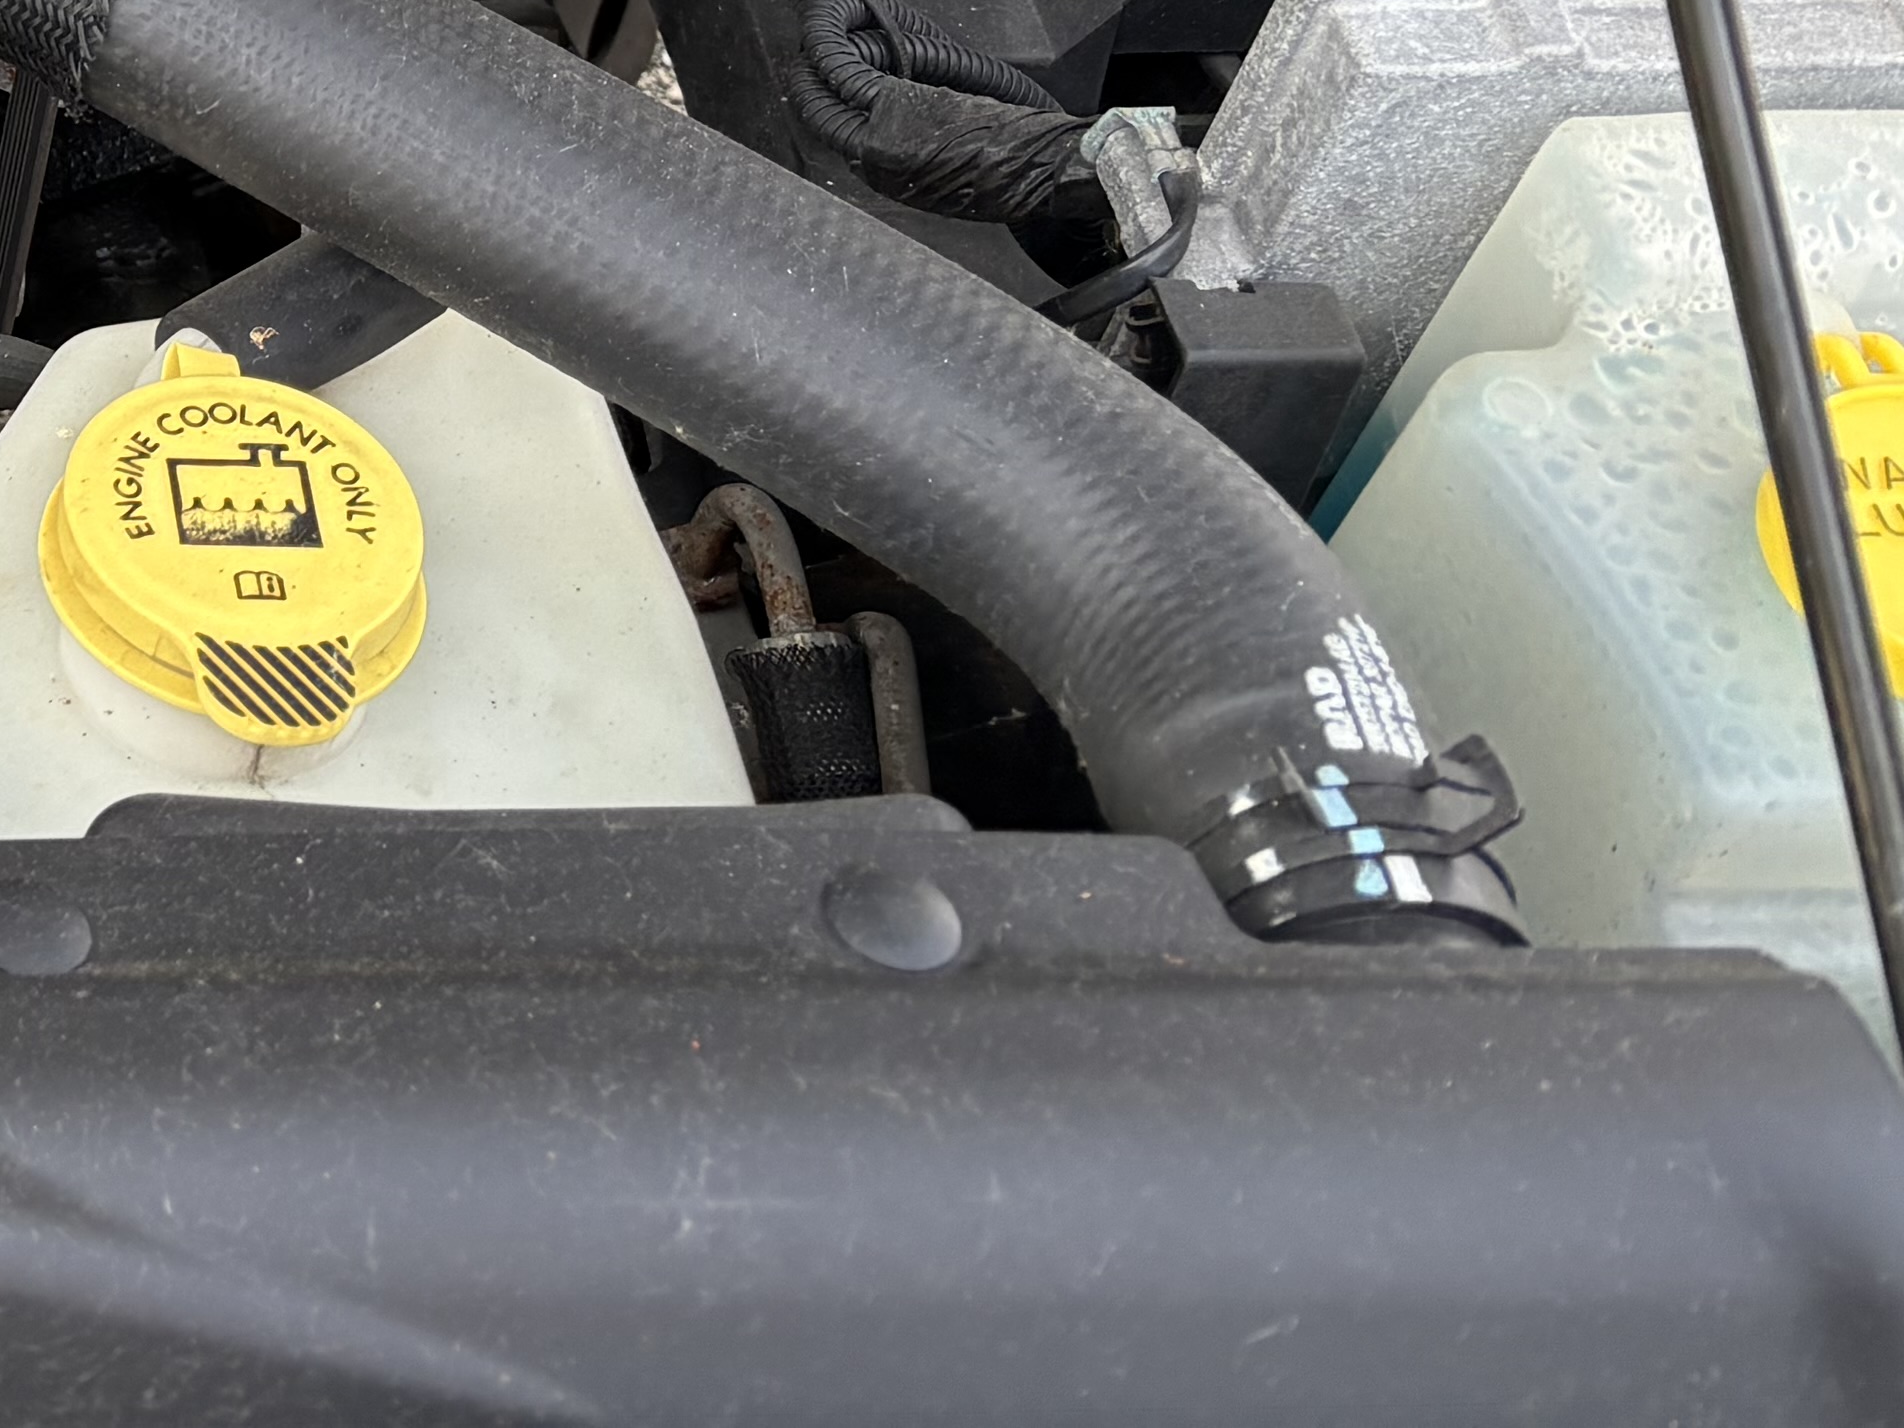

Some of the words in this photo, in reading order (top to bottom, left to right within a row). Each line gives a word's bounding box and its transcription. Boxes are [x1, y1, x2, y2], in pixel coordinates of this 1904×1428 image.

[112, 430, 161, 541] ENGINE
[156, 401, 337, 455] COOLANT
[331, 461, 378, 545] ONLY
